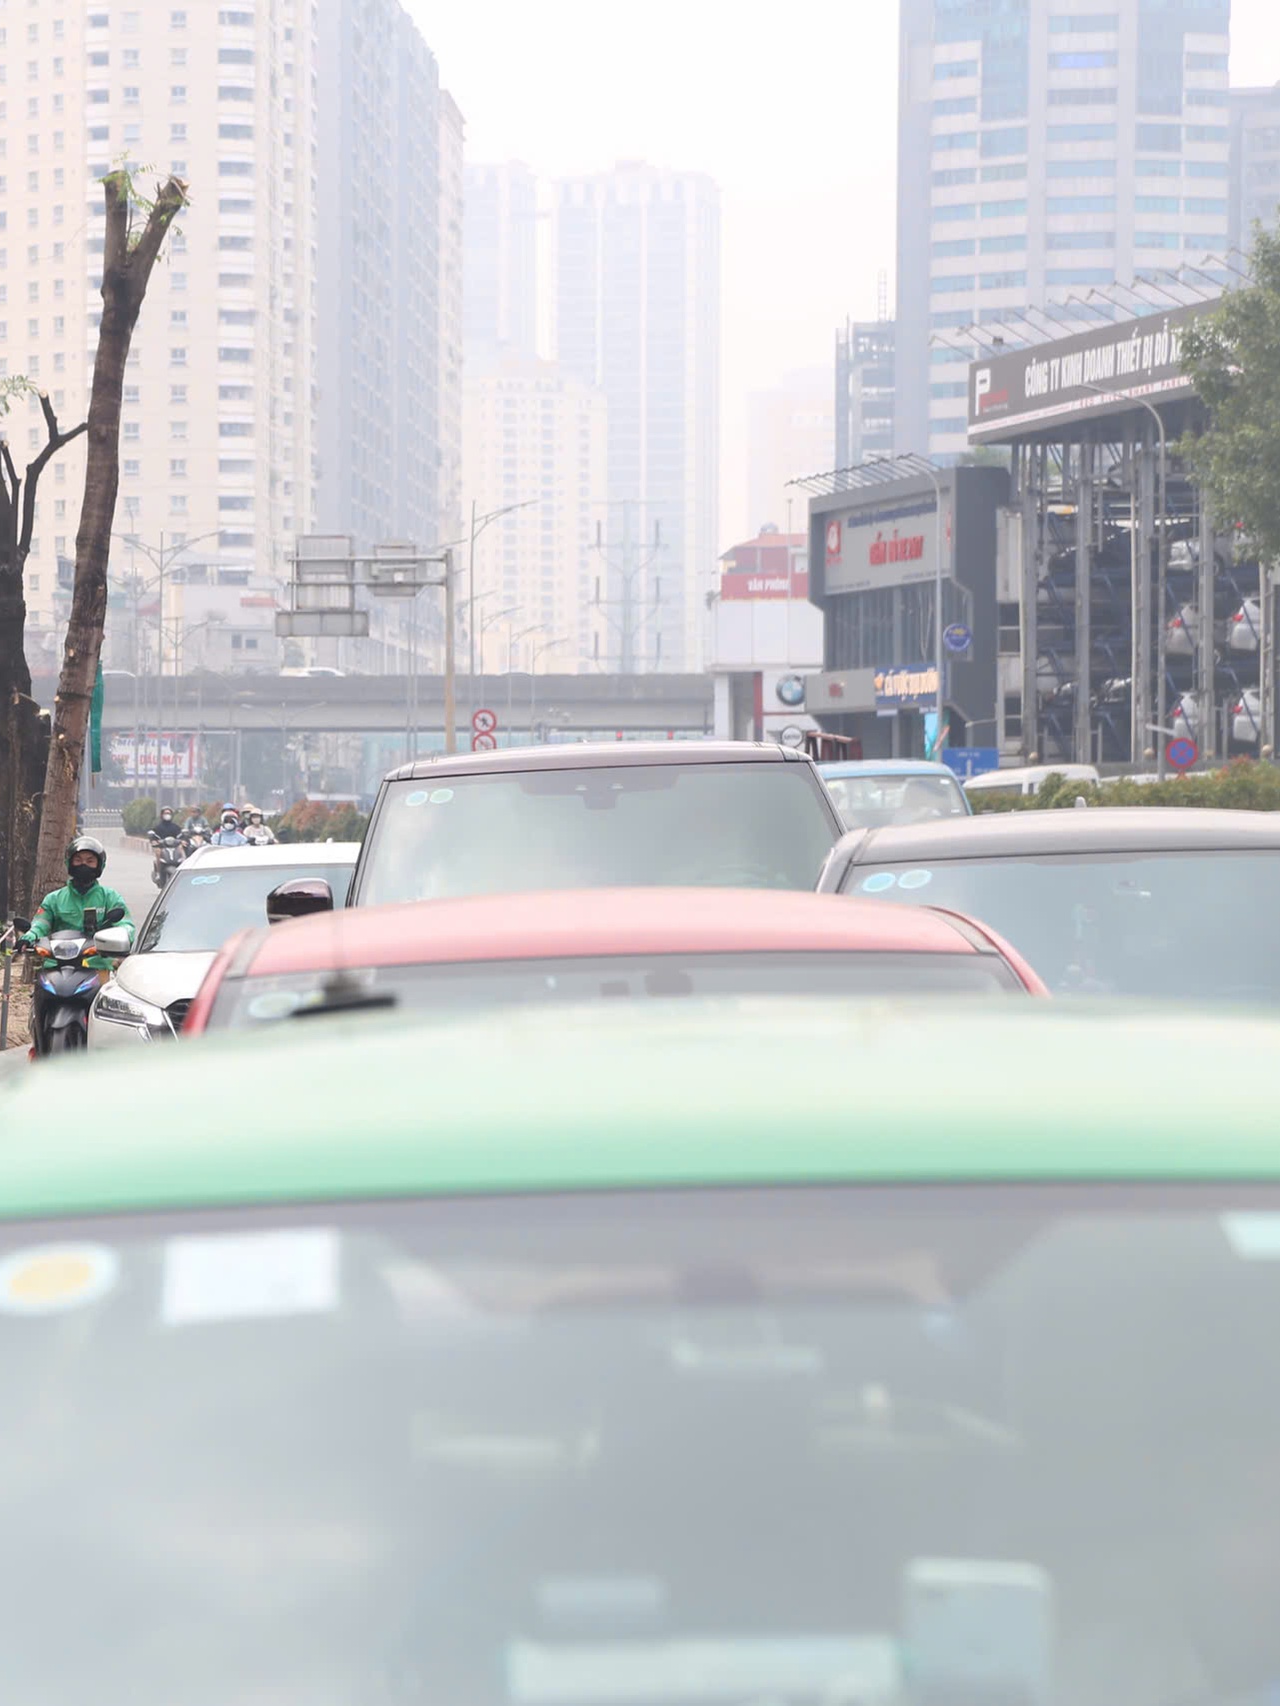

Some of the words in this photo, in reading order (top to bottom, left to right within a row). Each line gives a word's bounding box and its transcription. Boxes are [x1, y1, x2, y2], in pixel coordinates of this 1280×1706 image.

[1025, 358, 1049, 397] CÔNG
[1049, 359, 1061, 391] TY
[1061, 352, 1083, 388] KINH
[1084, 344, 1114, 384] DOANH
[1117, 328, 1141, 375] THIẾT
[1142, 335, 1153, 375] BỊ
